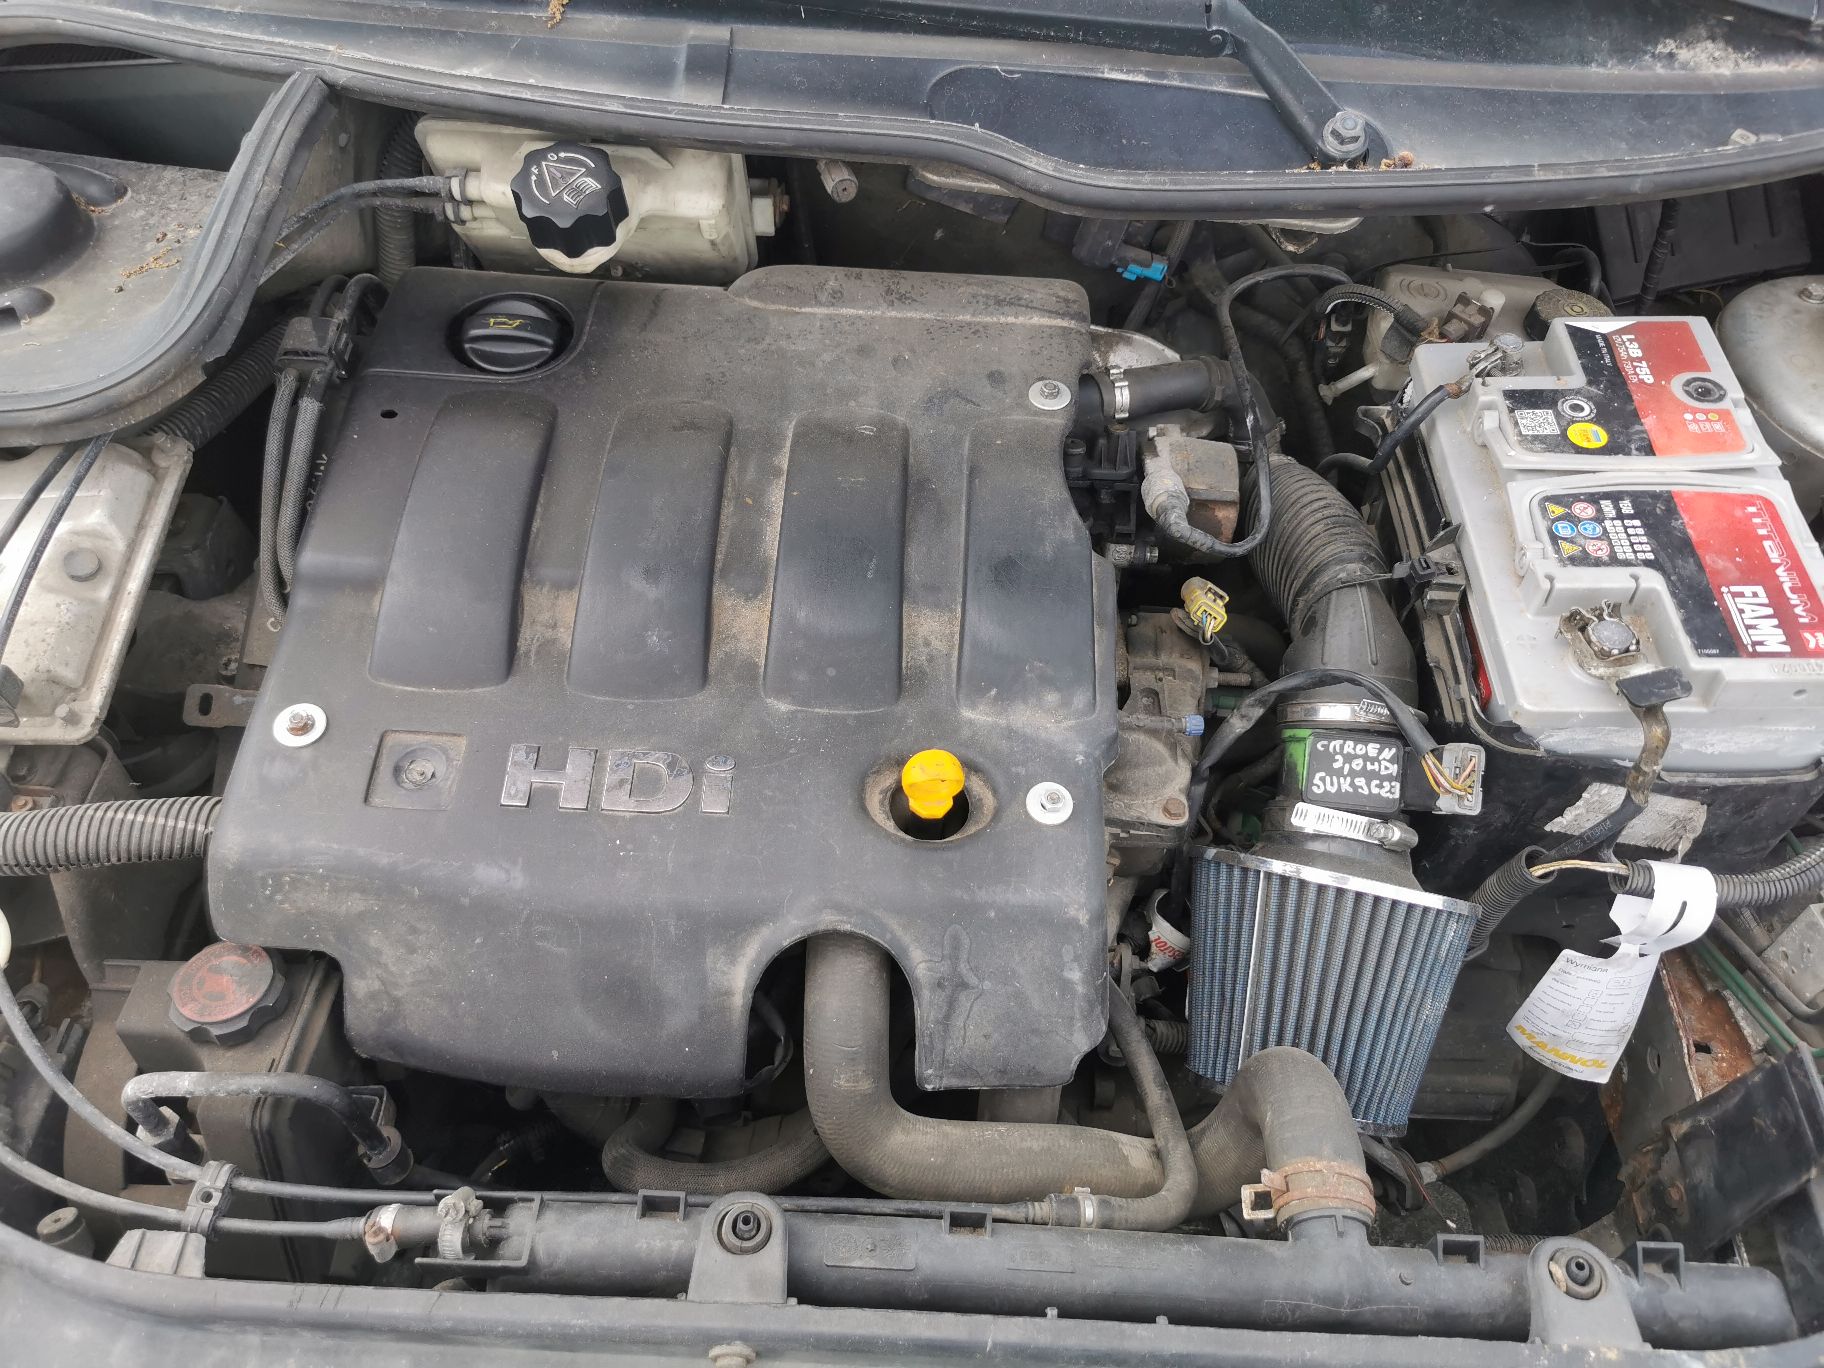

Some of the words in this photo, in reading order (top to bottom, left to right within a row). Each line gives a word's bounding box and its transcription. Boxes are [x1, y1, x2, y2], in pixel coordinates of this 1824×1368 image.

[1621, 334, 1643, 358] L3B
[1632, 361, 1655, 384] 75P
[1730, 585, 1792, 653] FIAMM
[500, 744, 736, 815] HDi
[1316, 739, 1397, 761] CITROEN
